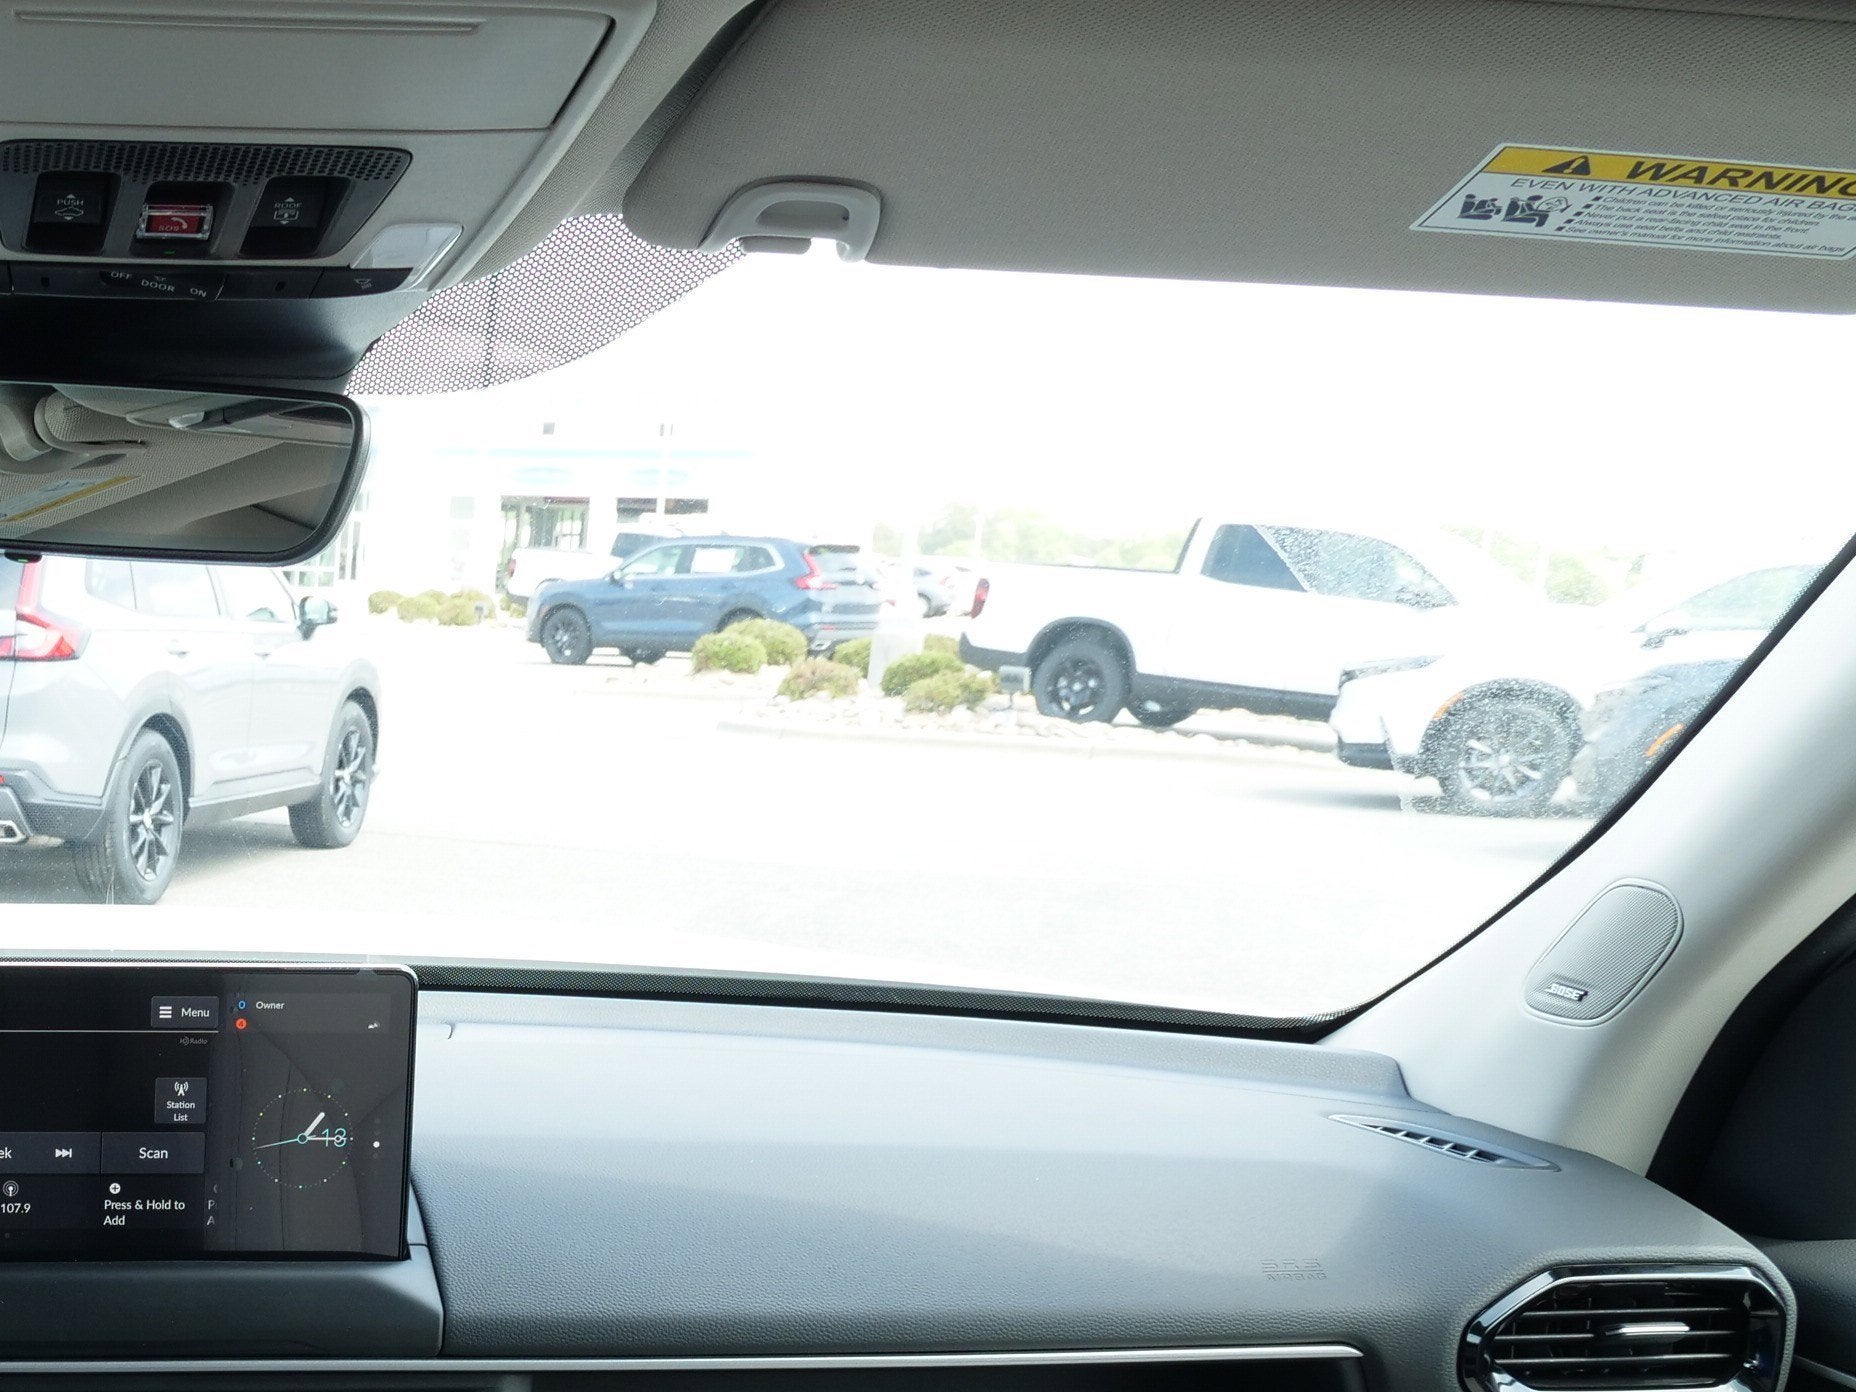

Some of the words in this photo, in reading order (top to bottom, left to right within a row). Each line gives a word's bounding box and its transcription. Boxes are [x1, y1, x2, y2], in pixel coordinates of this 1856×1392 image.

[1511, 178, 1574, 191] EVEN
[1579, 183, 1639, 195] WITH
[1640, 187, 1763, 205] ADVANCED
[1767, 197, 1804, 208] AIR
[56, 197, 84, 208] PUSH
[274, 200, 303, 210] ROOF
[110, 270, 132, 280] OFF
[140, 280, 175, 292] DOOR
[189, 287, 207, 298] ON
[255, 1001, 285, 1010] Owner
[181, 1007, 210, 1018] Menu
[166, 1100, 196, 1109] Station
[173, 1112, 189, 1122] List
[138, 1146, 169, 1159] Scan
[0, 1202, 31, 1214] 107.9
[104, 1199, 132, 1211] Press
[134, 1198, 145, 1211] &
[145, 1198, 172, 1211] Hold
[173, 1198, 187, 1211] to
[103, 1214, 126, 1226] Add
